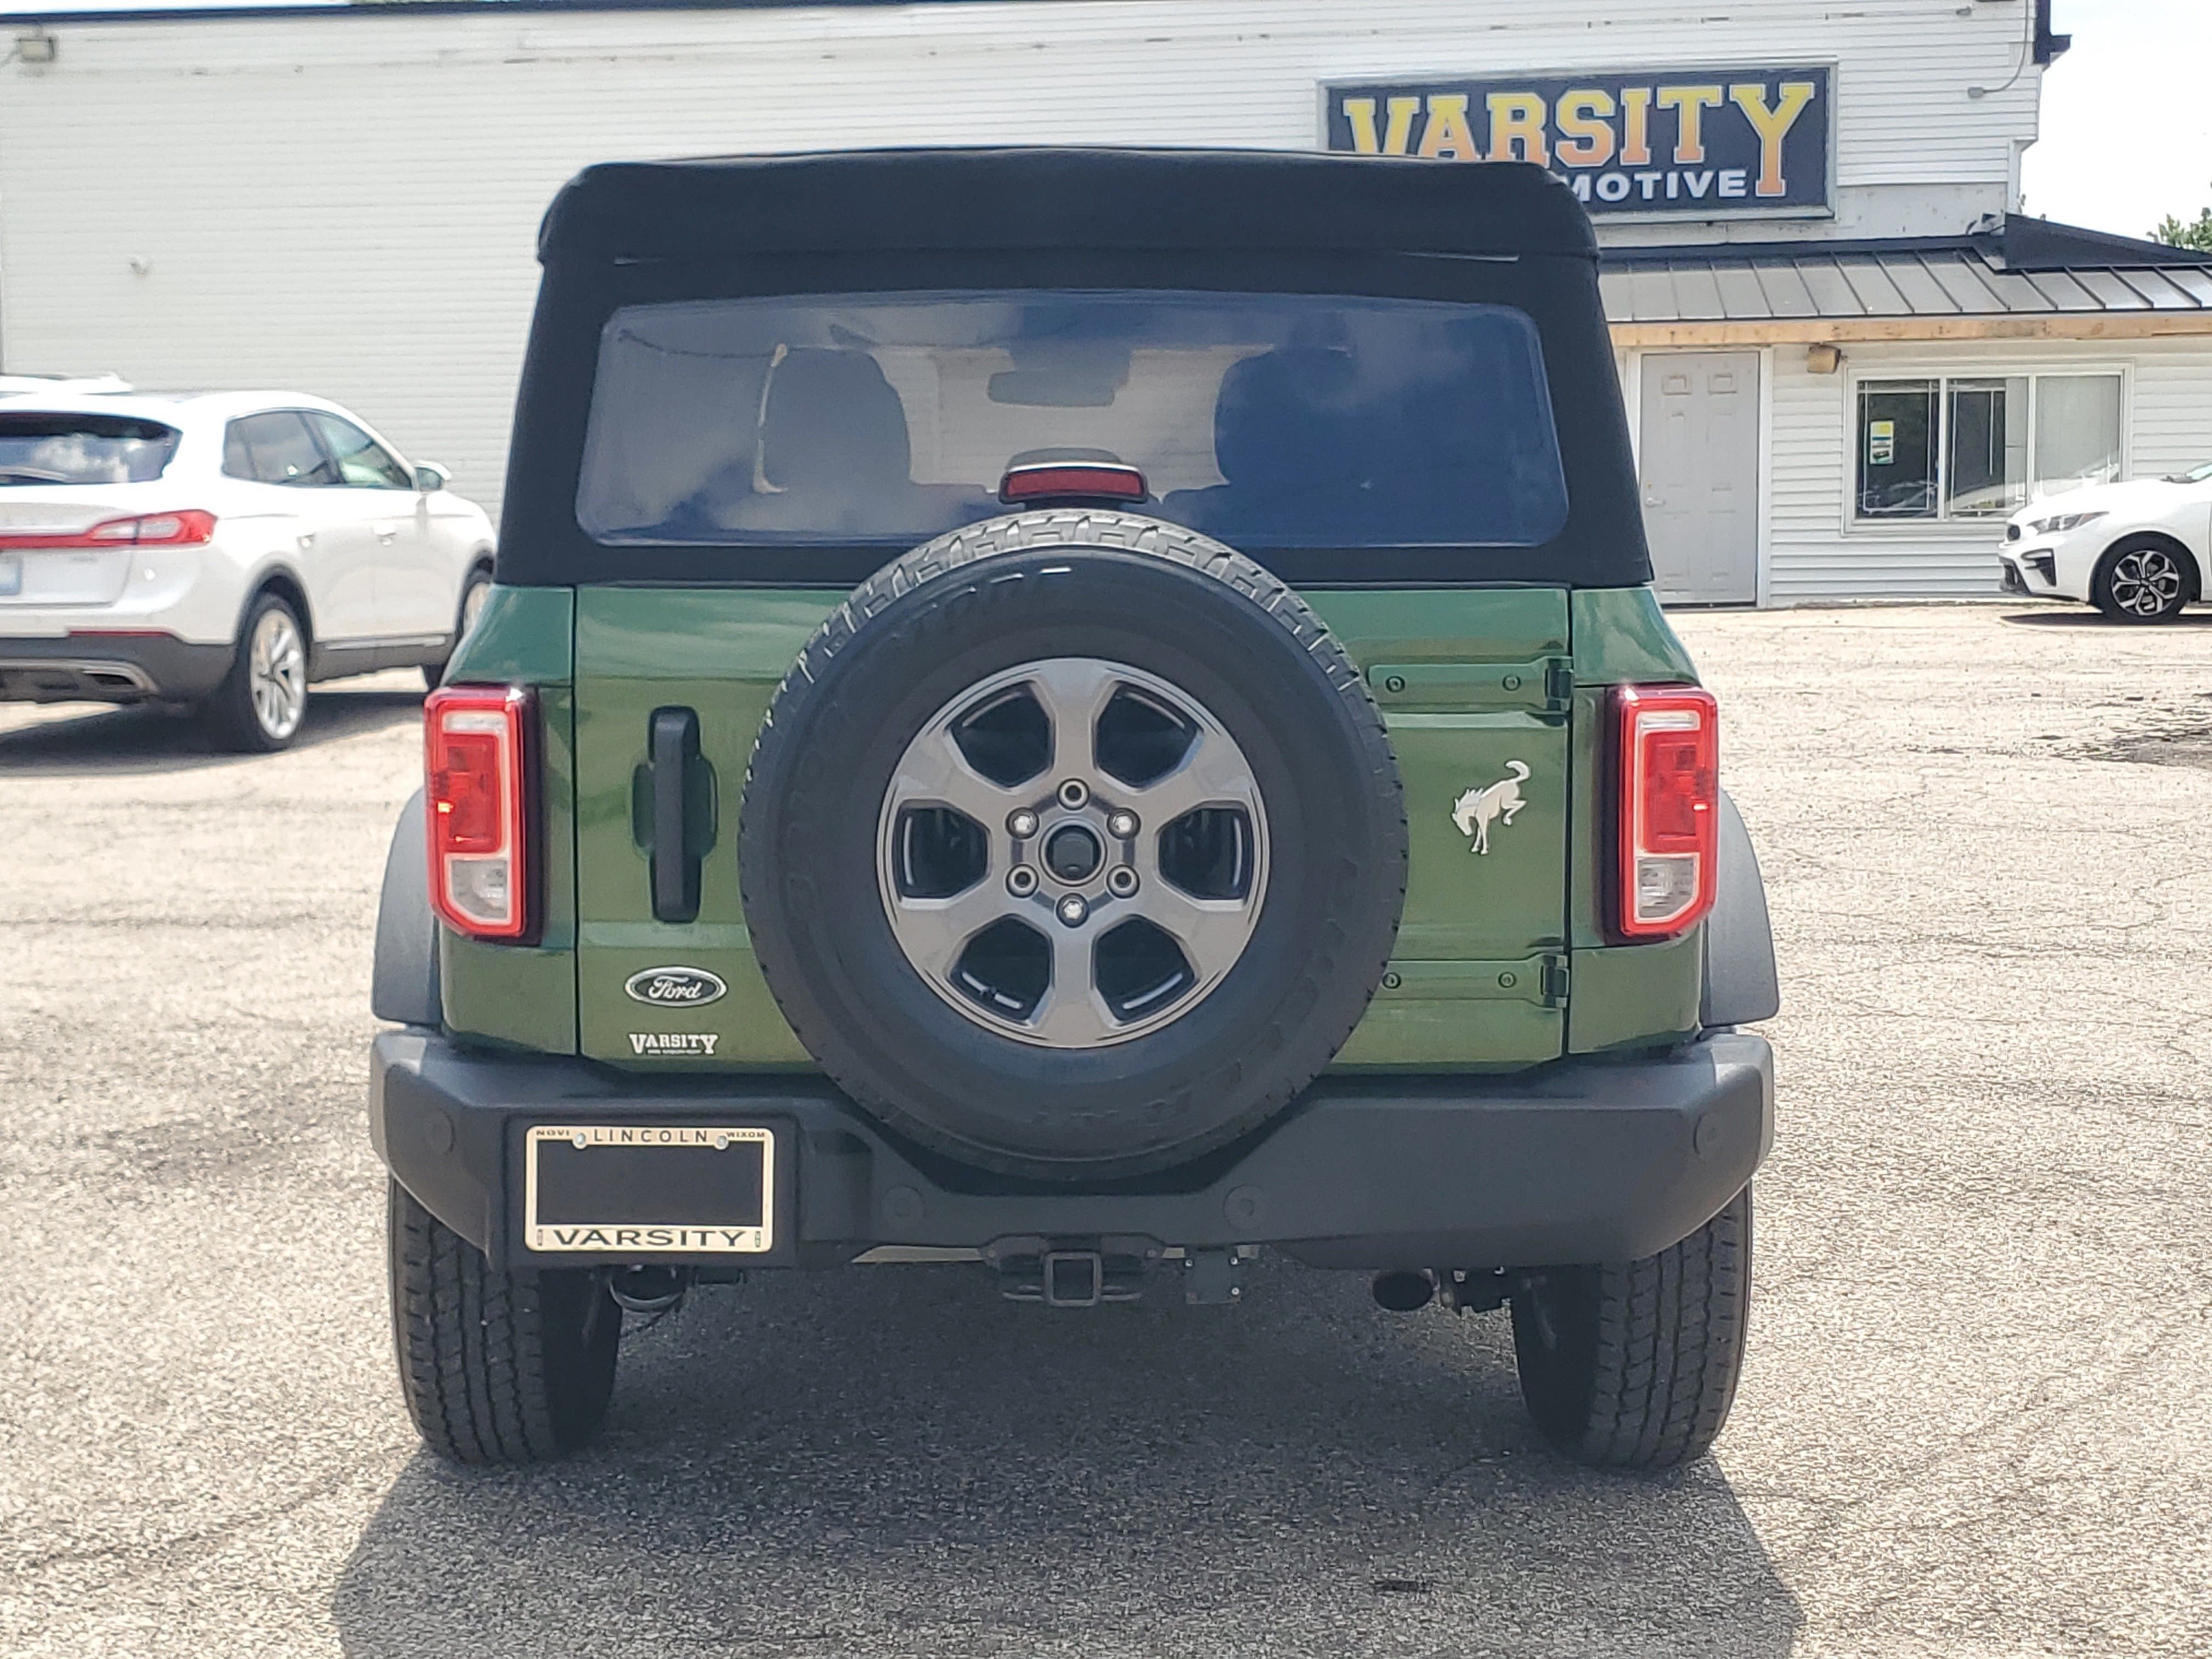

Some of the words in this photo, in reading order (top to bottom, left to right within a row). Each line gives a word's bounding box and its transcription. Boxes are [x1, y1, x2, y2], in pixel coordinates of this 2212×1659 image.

[1343, 81, 1814, 197] VARSITY
[648, 975, 703, 998] Ford
[628, 1033, 719, 1054] VARSITY
[594, 1129, 708, 1143] LINCOLN
[553, 1229, 747, 1247] VARSITY
